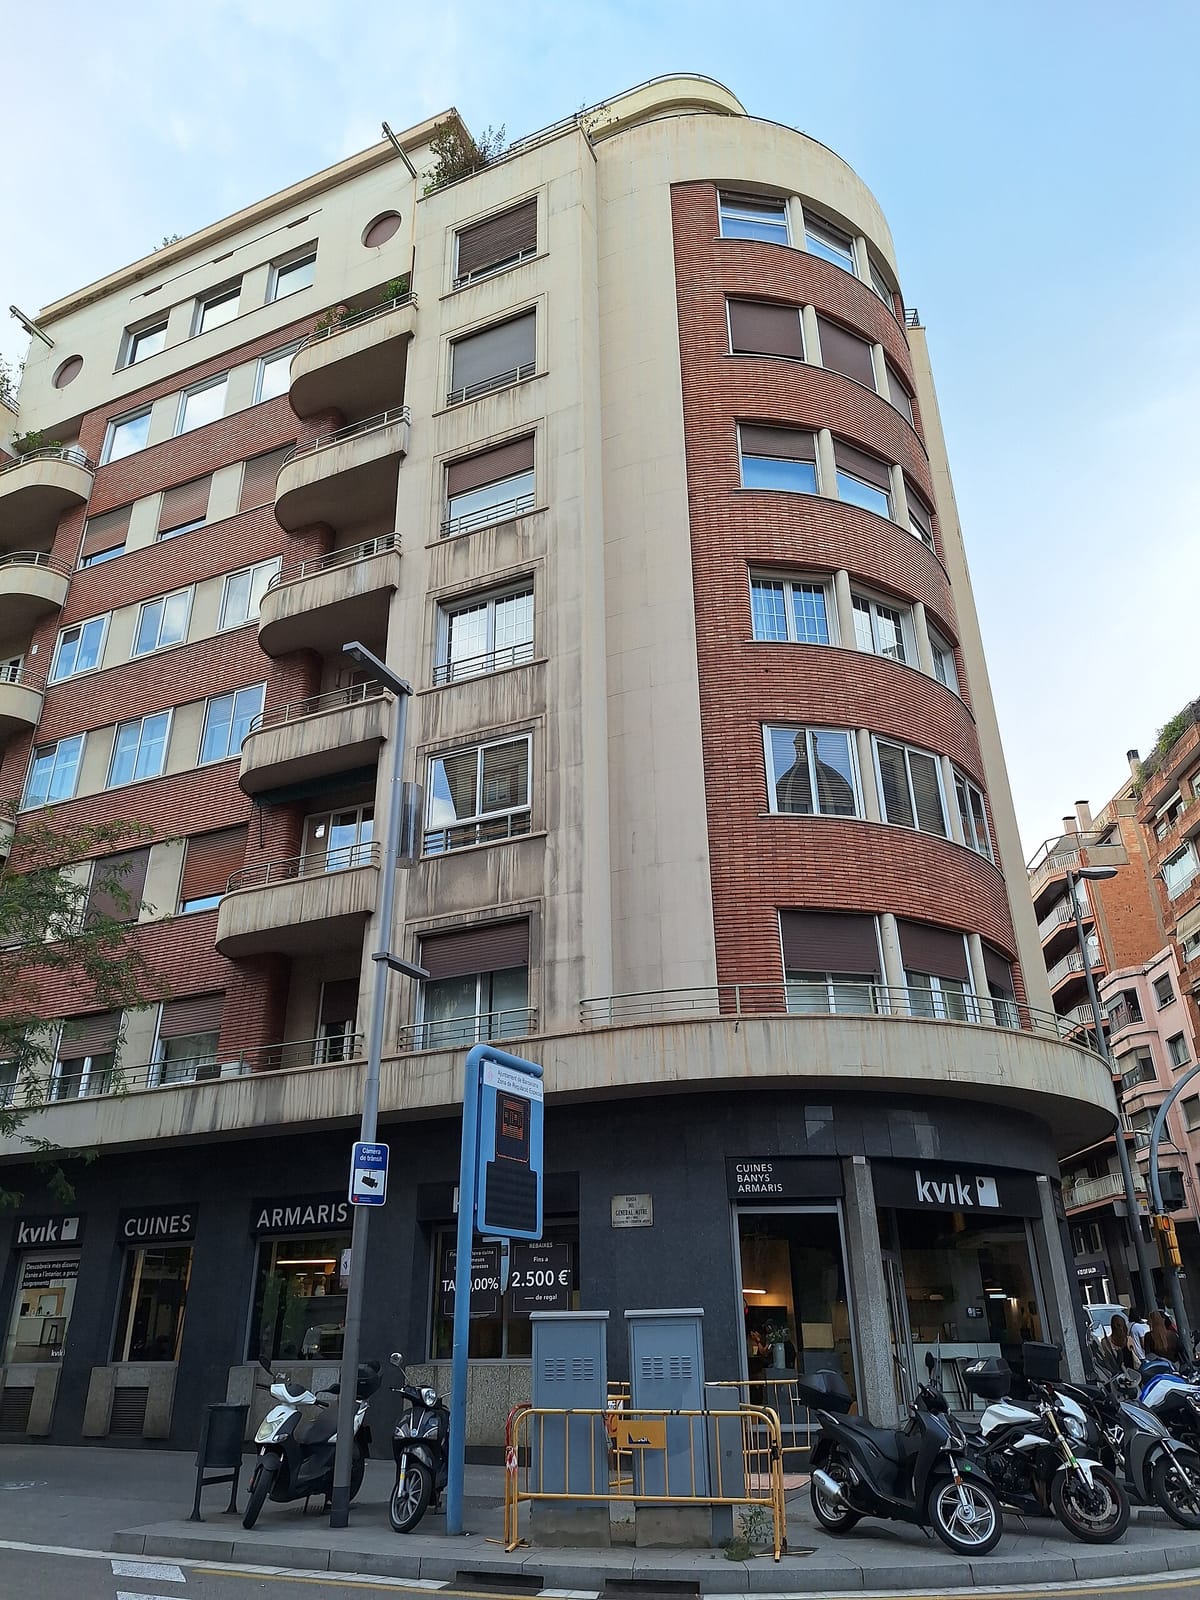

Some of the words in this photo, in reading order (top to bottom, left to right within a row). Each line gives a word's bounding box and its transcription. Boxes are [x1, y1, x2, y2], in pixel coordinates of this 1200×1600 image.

[736, 1163, 773, 1173] CUINES
[737, 1173, 770, 1183] BANYS
[738, 1183, 783, 1193] ARMARIS
[915, 1170, 974, 1206] kvik
[256, 1203, 348, 1228] ARMARIS
[17, 1219, 59, 1244] kvik
[124, 1214, 192, 1237] CUINES
[511, 1270, 554, 1287] 2.500
[543, 1294, 558, 1302] regal
